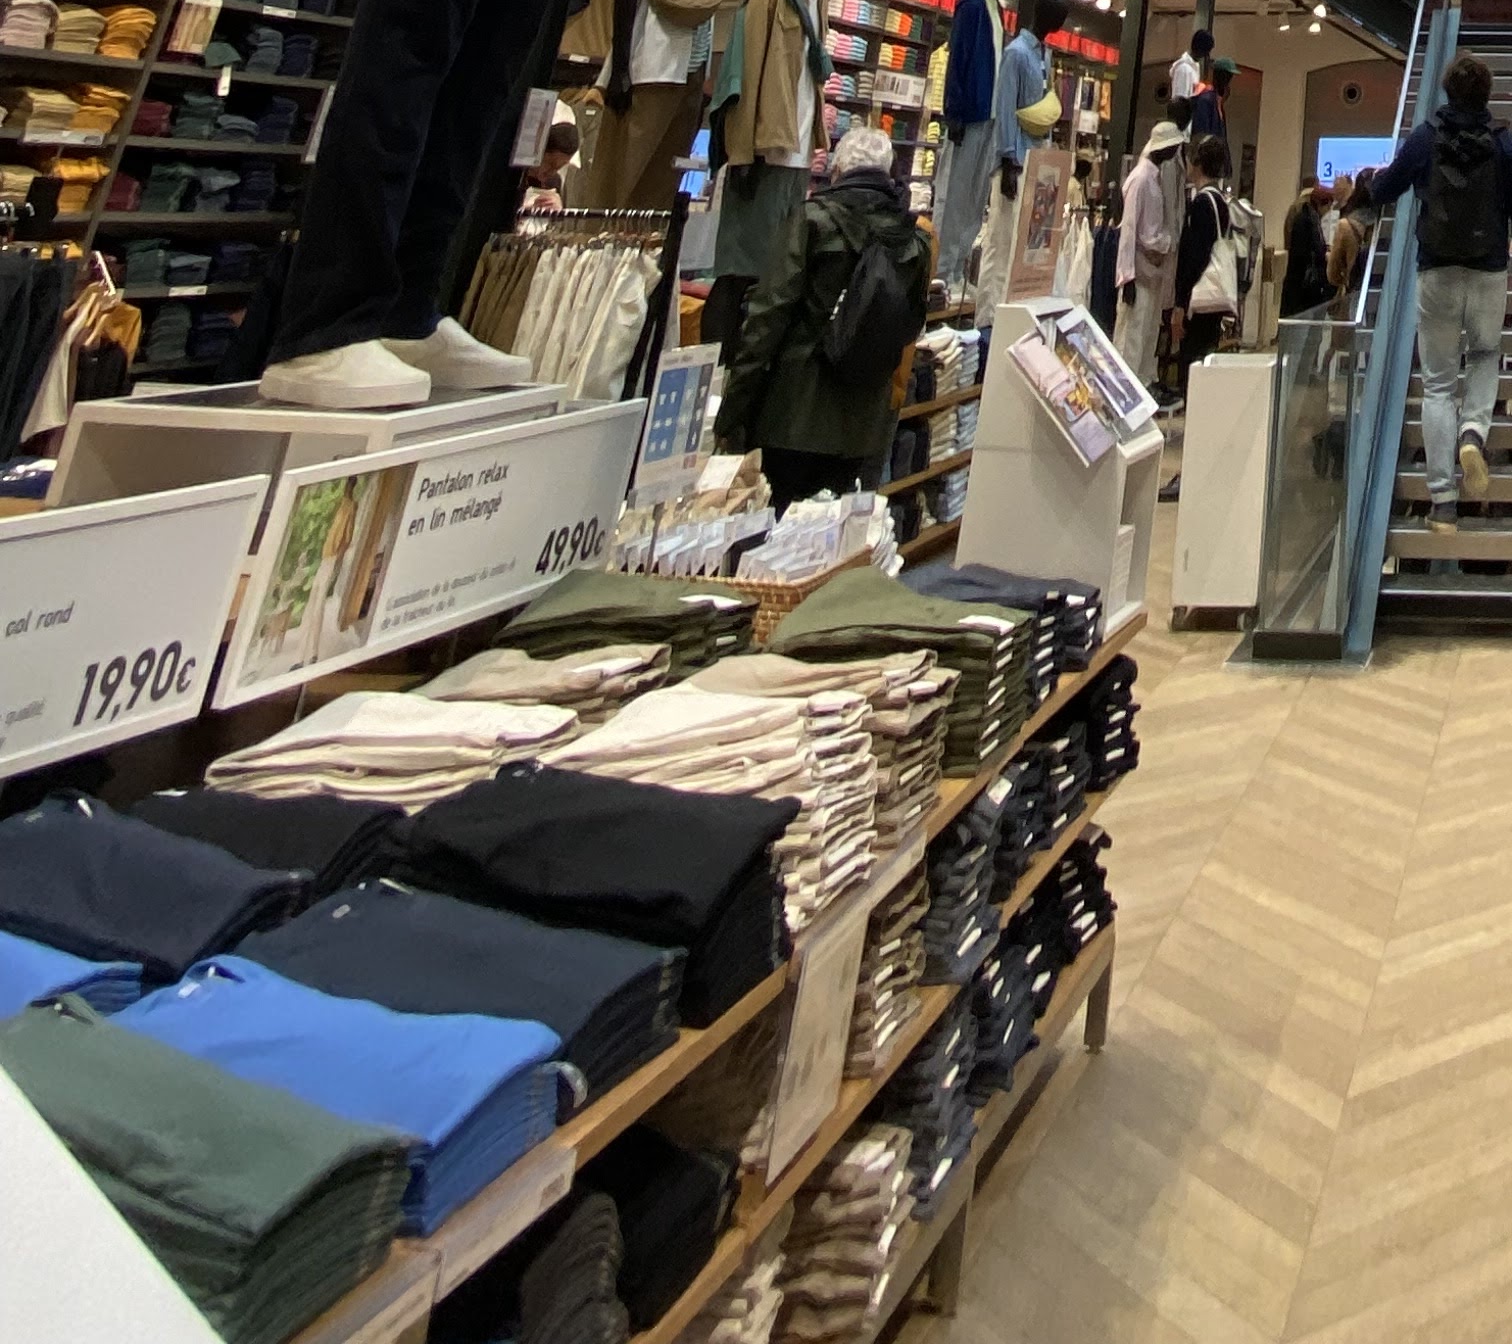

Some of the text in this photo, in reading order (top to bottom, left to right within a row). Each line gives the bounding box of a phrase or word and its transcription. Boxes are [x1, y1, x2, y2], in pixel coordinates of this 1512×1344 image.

[1323, 160, 1333, 178] 3
[416, 461, 510, 502] Pantalon relax
[407, 491, 503, 537] en lin mélangé
[5, 599, 76, 638] col rond
[72, 639, 197, 728] 19,90€
